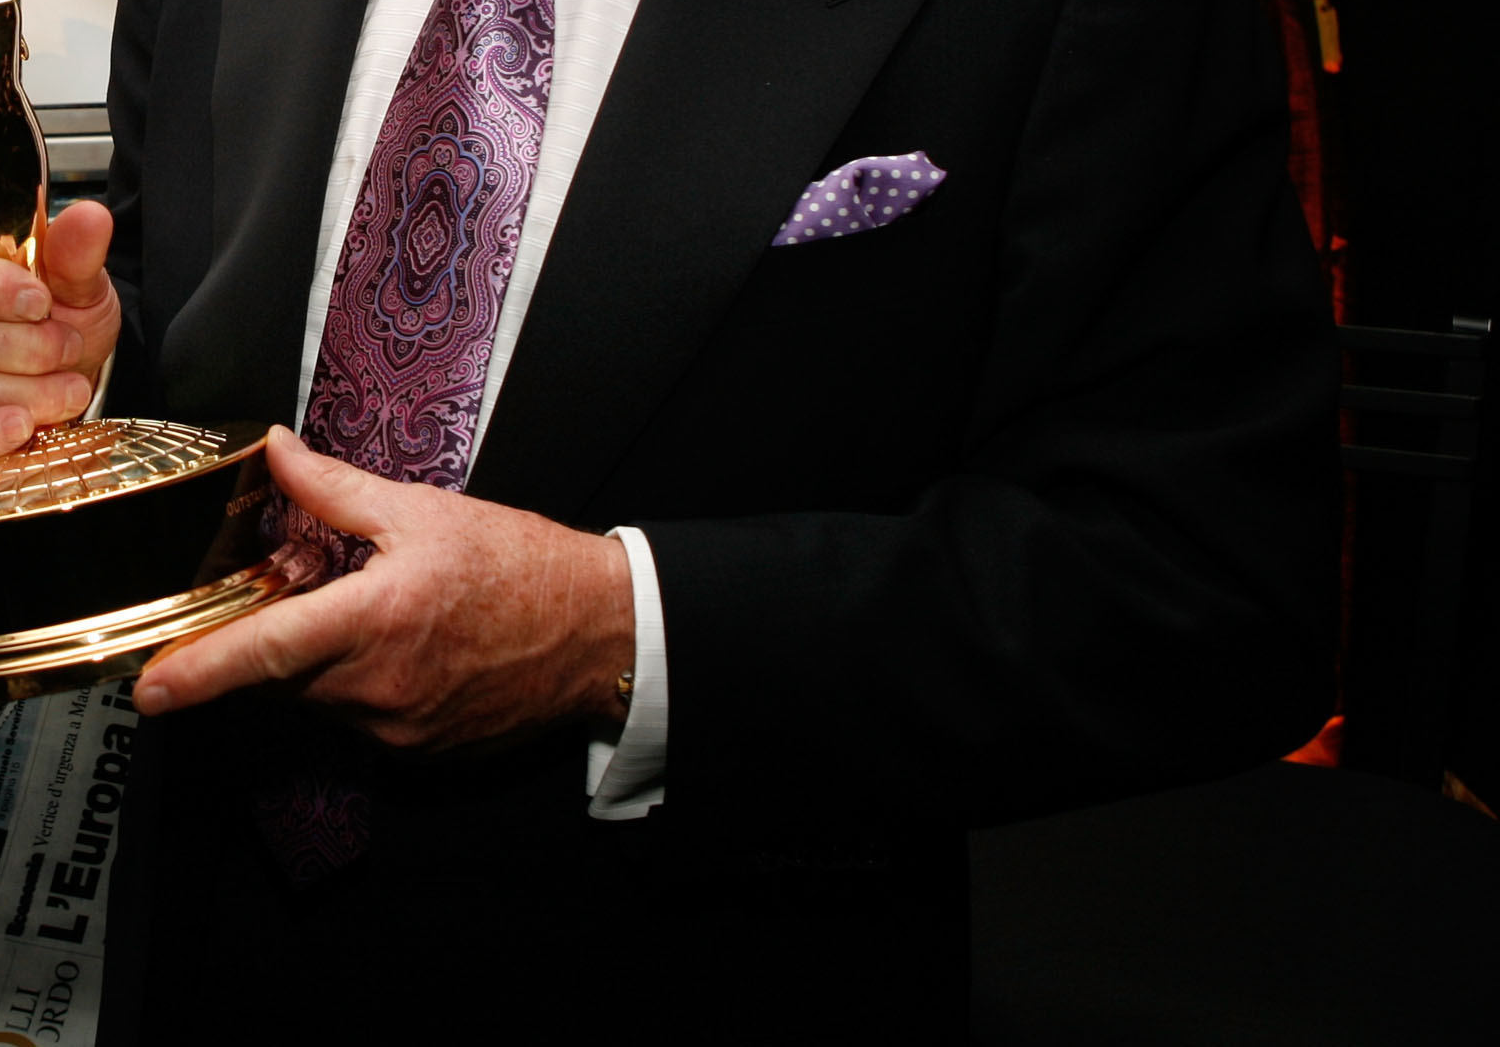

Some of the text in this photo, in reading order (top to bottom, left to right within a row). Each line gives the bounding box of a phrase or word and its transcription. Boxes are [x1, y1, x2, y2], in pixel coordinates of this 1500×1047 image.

[32, 799, 60, 846] Vertice
[47, 732, 78, 798] d'urgenza
[36, 722, 140, 945] L'Europa
